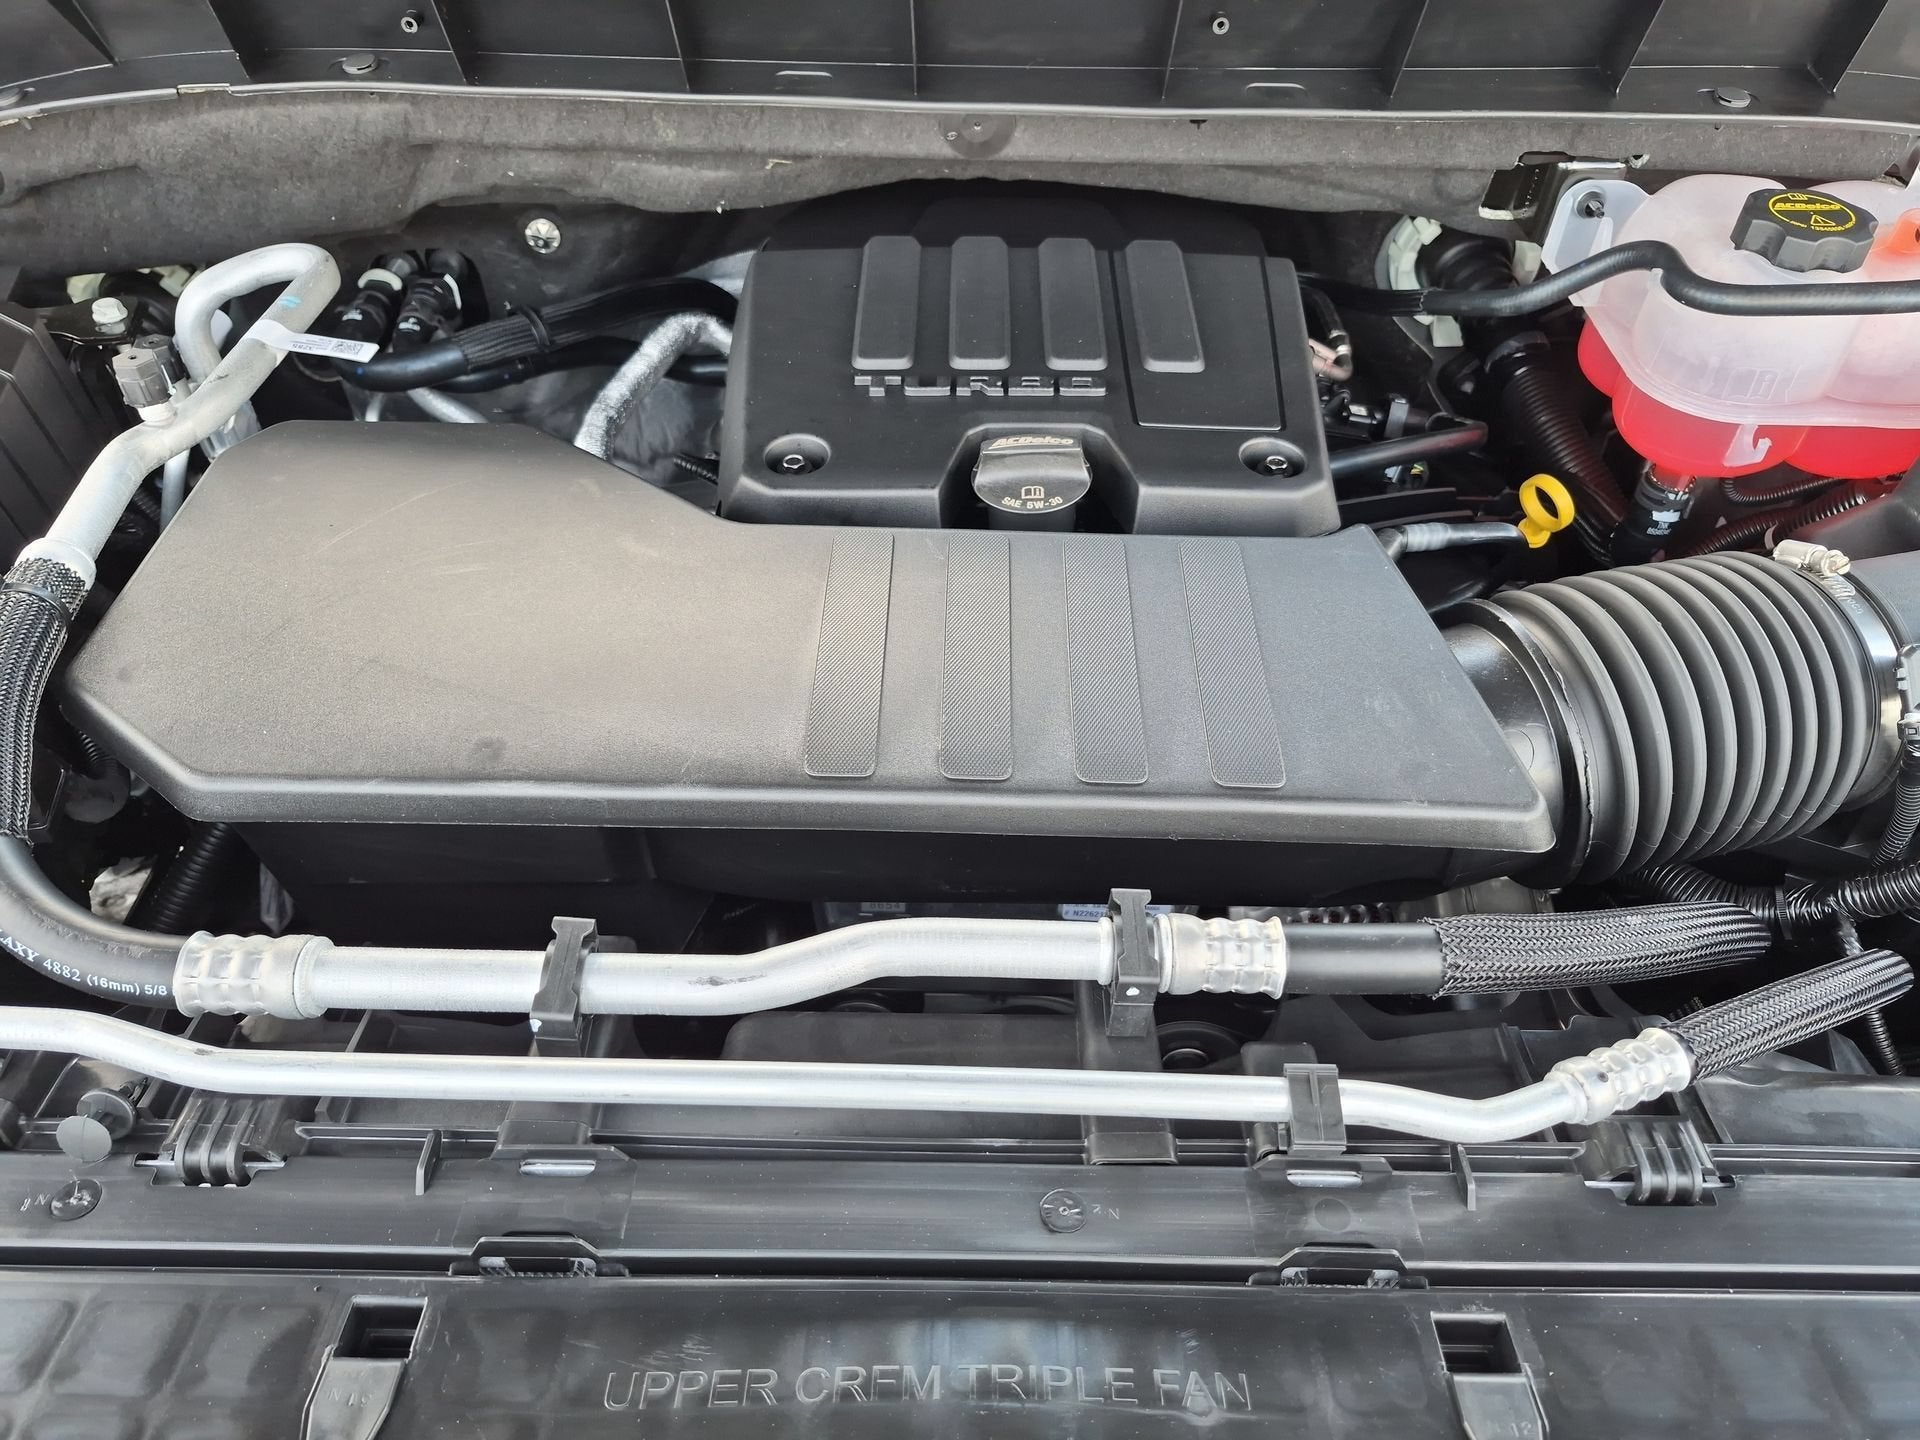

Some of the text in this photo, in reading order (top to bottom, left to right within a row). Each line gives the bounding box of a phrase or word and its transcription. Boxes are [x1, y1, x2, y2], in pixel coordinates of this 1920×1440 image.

[1773, 202, 1842, 212] ACDelco
[854, 375, 1107, 397] TURBO
[988, 436, 1074, 448] ACDelco
[1001, 496, 1064, 509] SAE 5W-30
[43, 958, 81, 982] 4882
[86, 974, 140, 996] (16mm)
[144, 984, 168, 996] 5/8
[603, 1367, 779, 1411] UPPER
[956, 1363, 1138, 1404] TRIPLE
[1154, 1367, 1253, 1412] FAN
